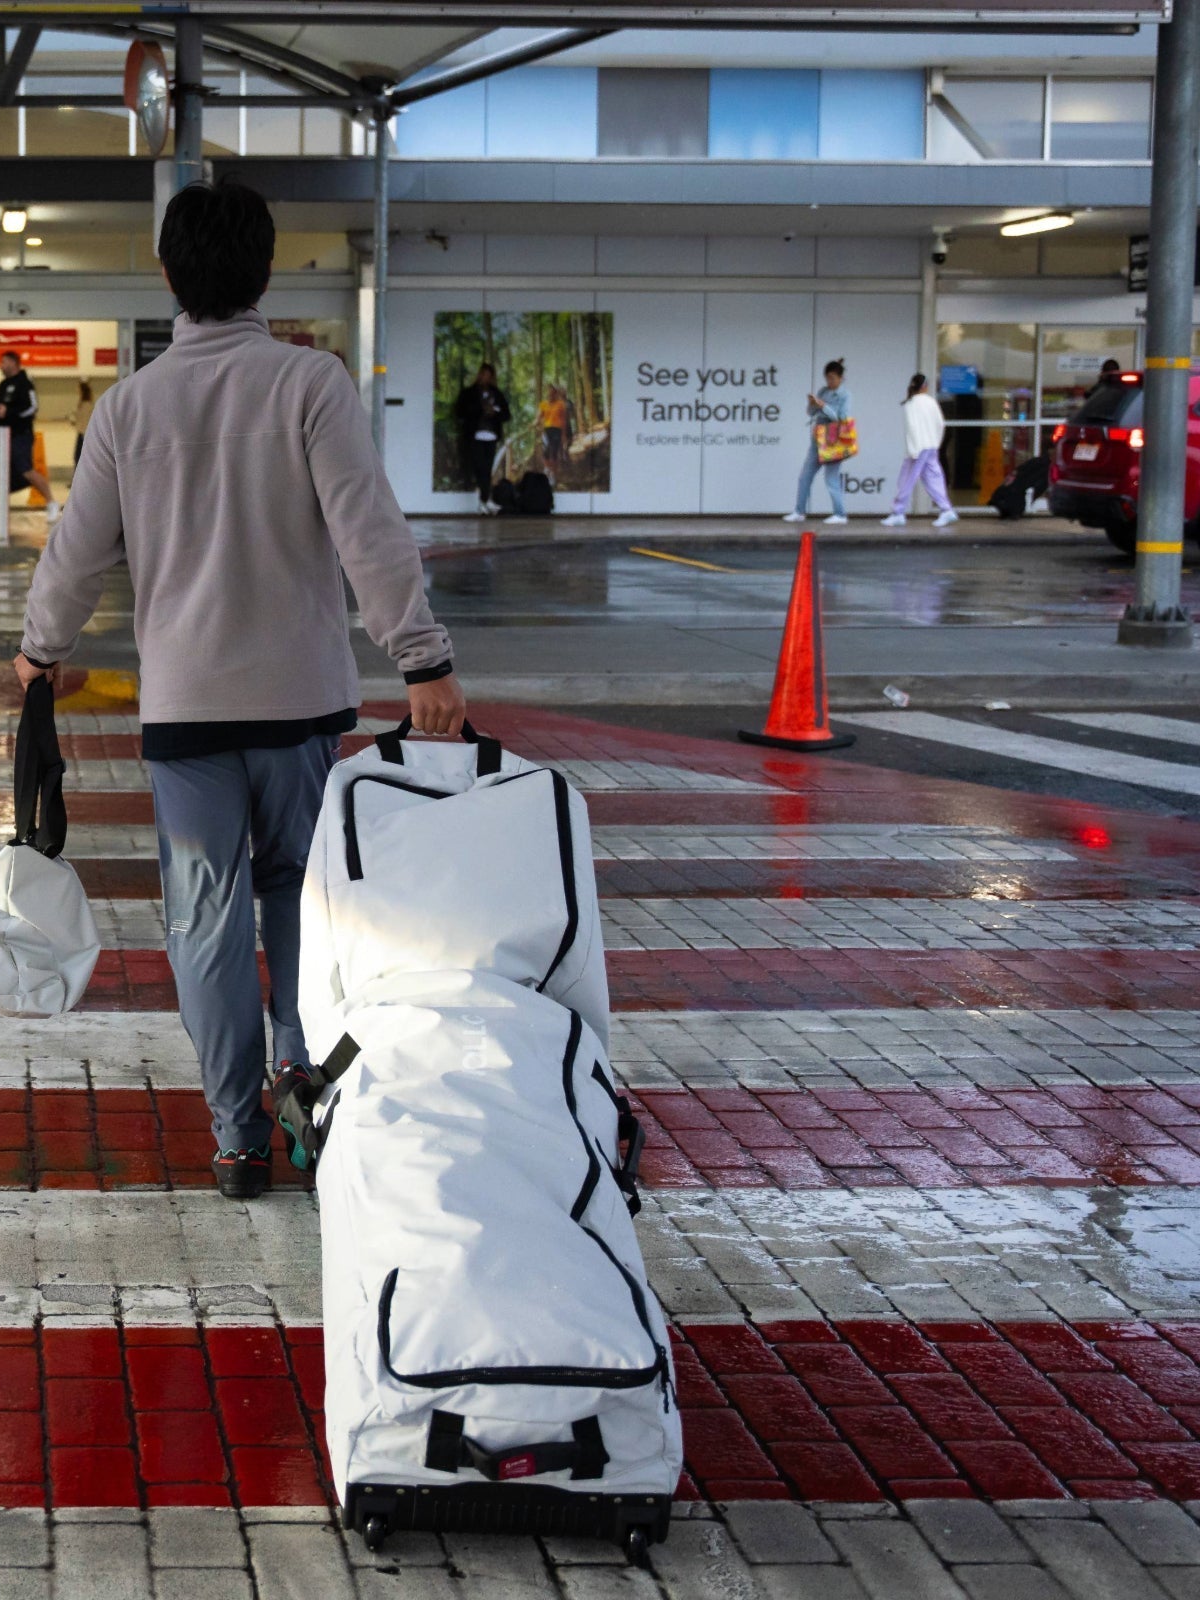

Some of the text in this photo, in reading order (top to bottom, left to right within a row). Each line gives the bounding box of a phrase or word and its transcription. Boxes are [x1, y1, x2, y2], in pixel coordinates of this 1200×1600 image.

[637, 363, 778, 392] See you at
[637, 398, 780, 422] Tamborine
[636, 433, 781, 446] Explore the GC with Uber
